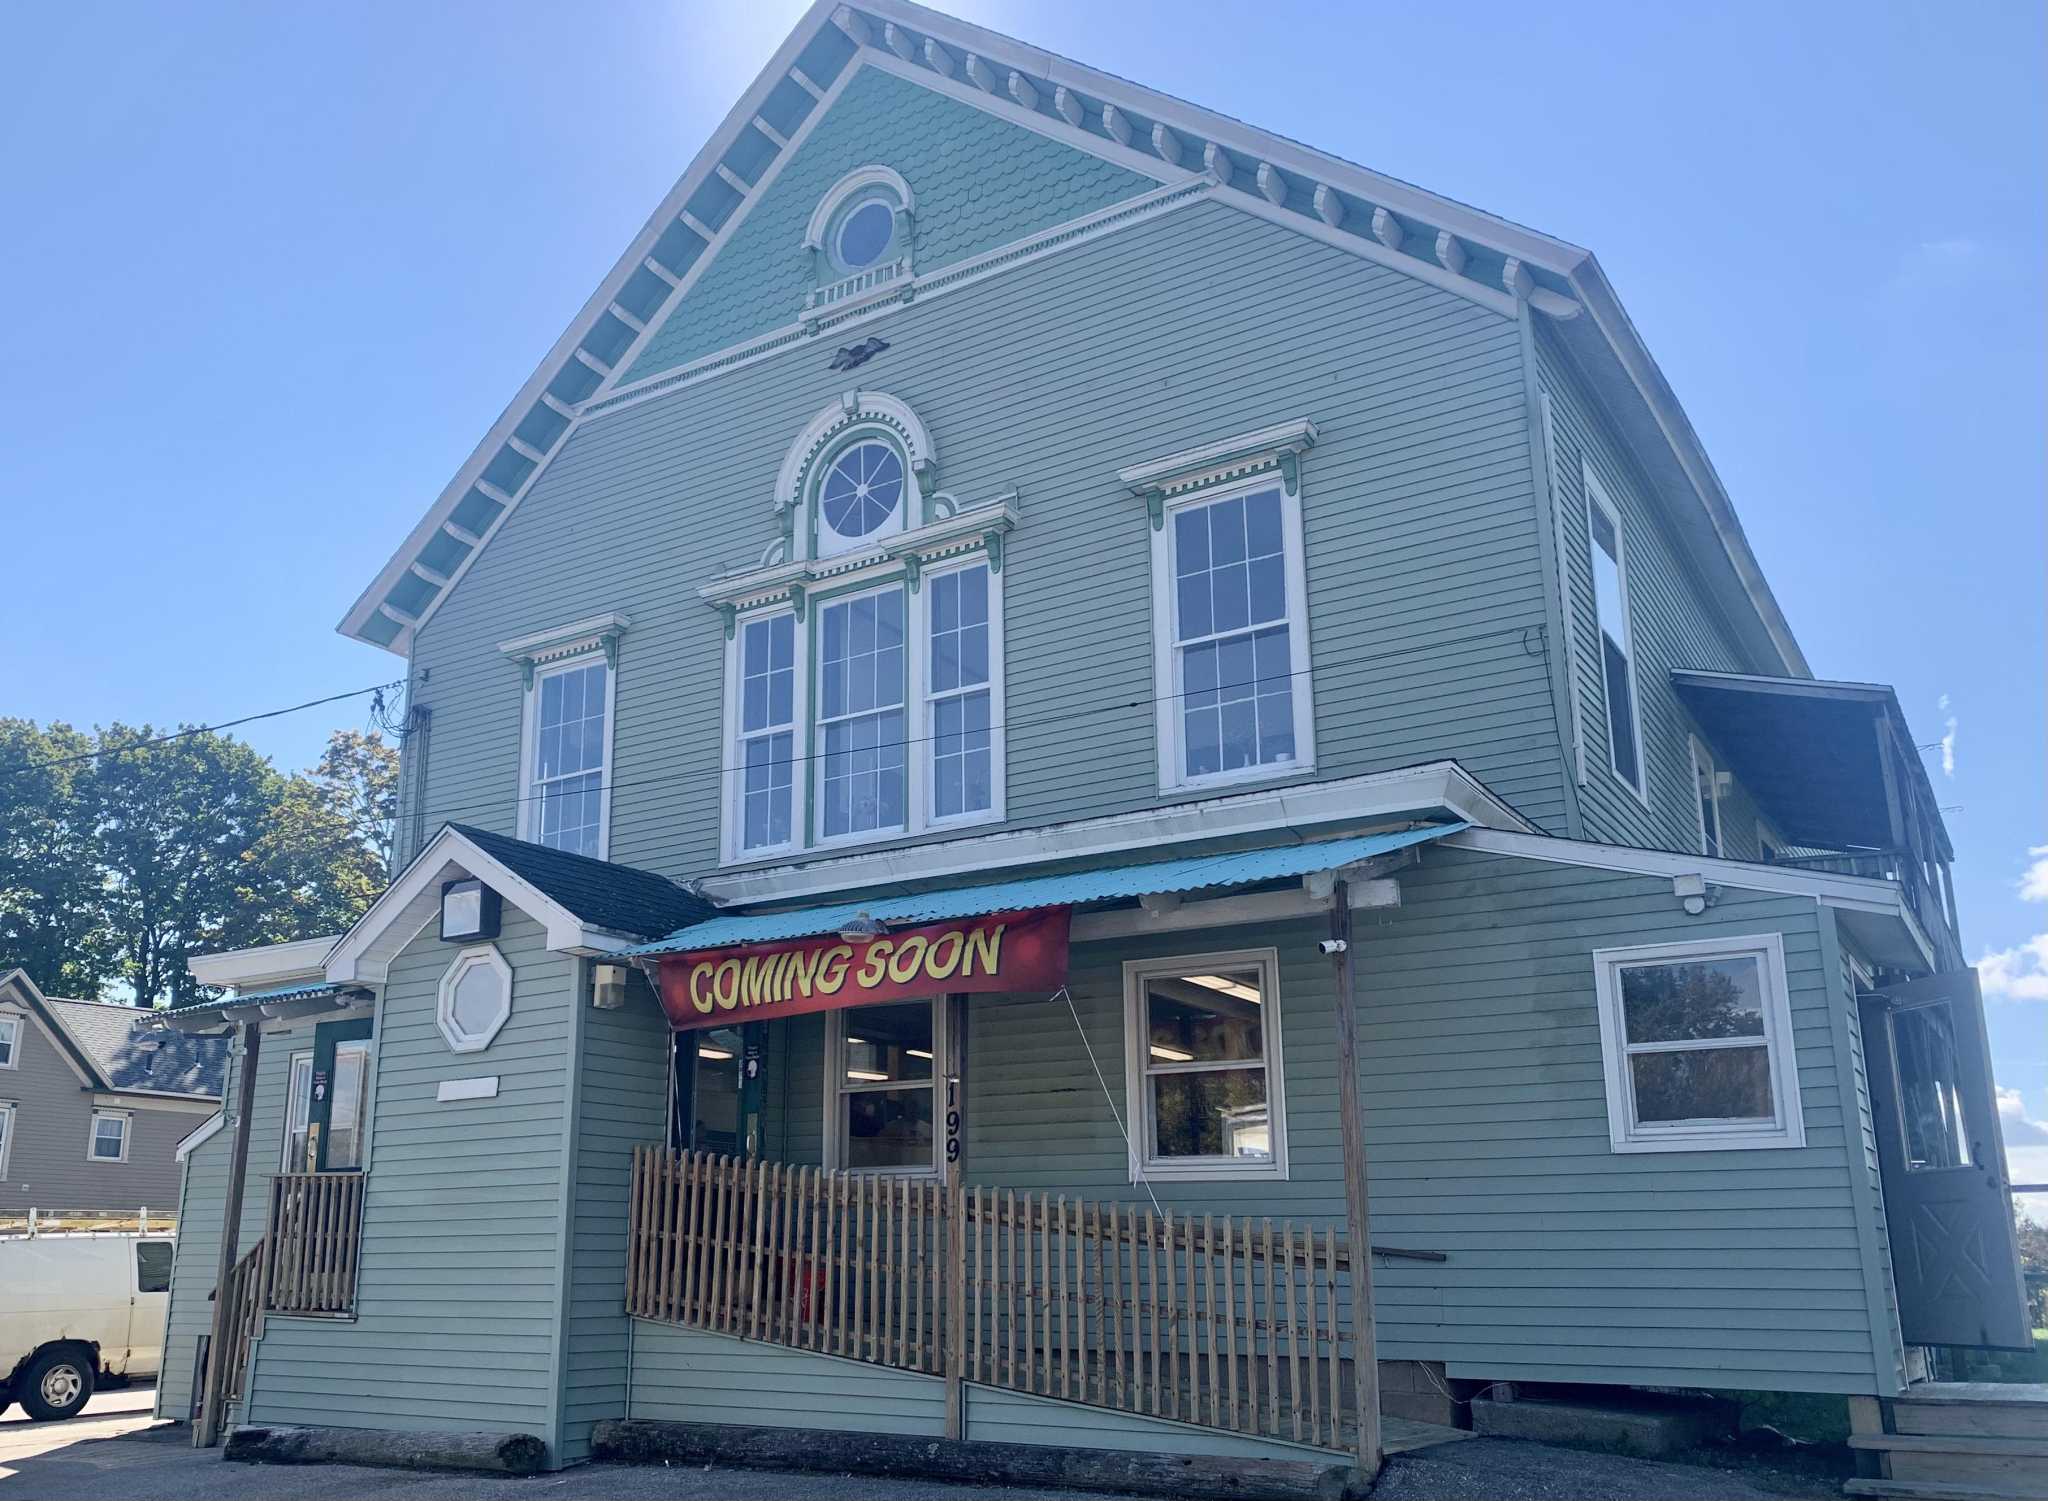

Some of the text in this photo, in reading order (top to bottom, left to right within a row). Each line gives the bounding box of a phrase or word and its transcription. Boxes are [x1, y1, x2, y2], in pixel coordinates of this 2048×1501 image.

[690, 924, 1006, 1014] COMING SOON
[946, 1082, 960, 1163] 199
